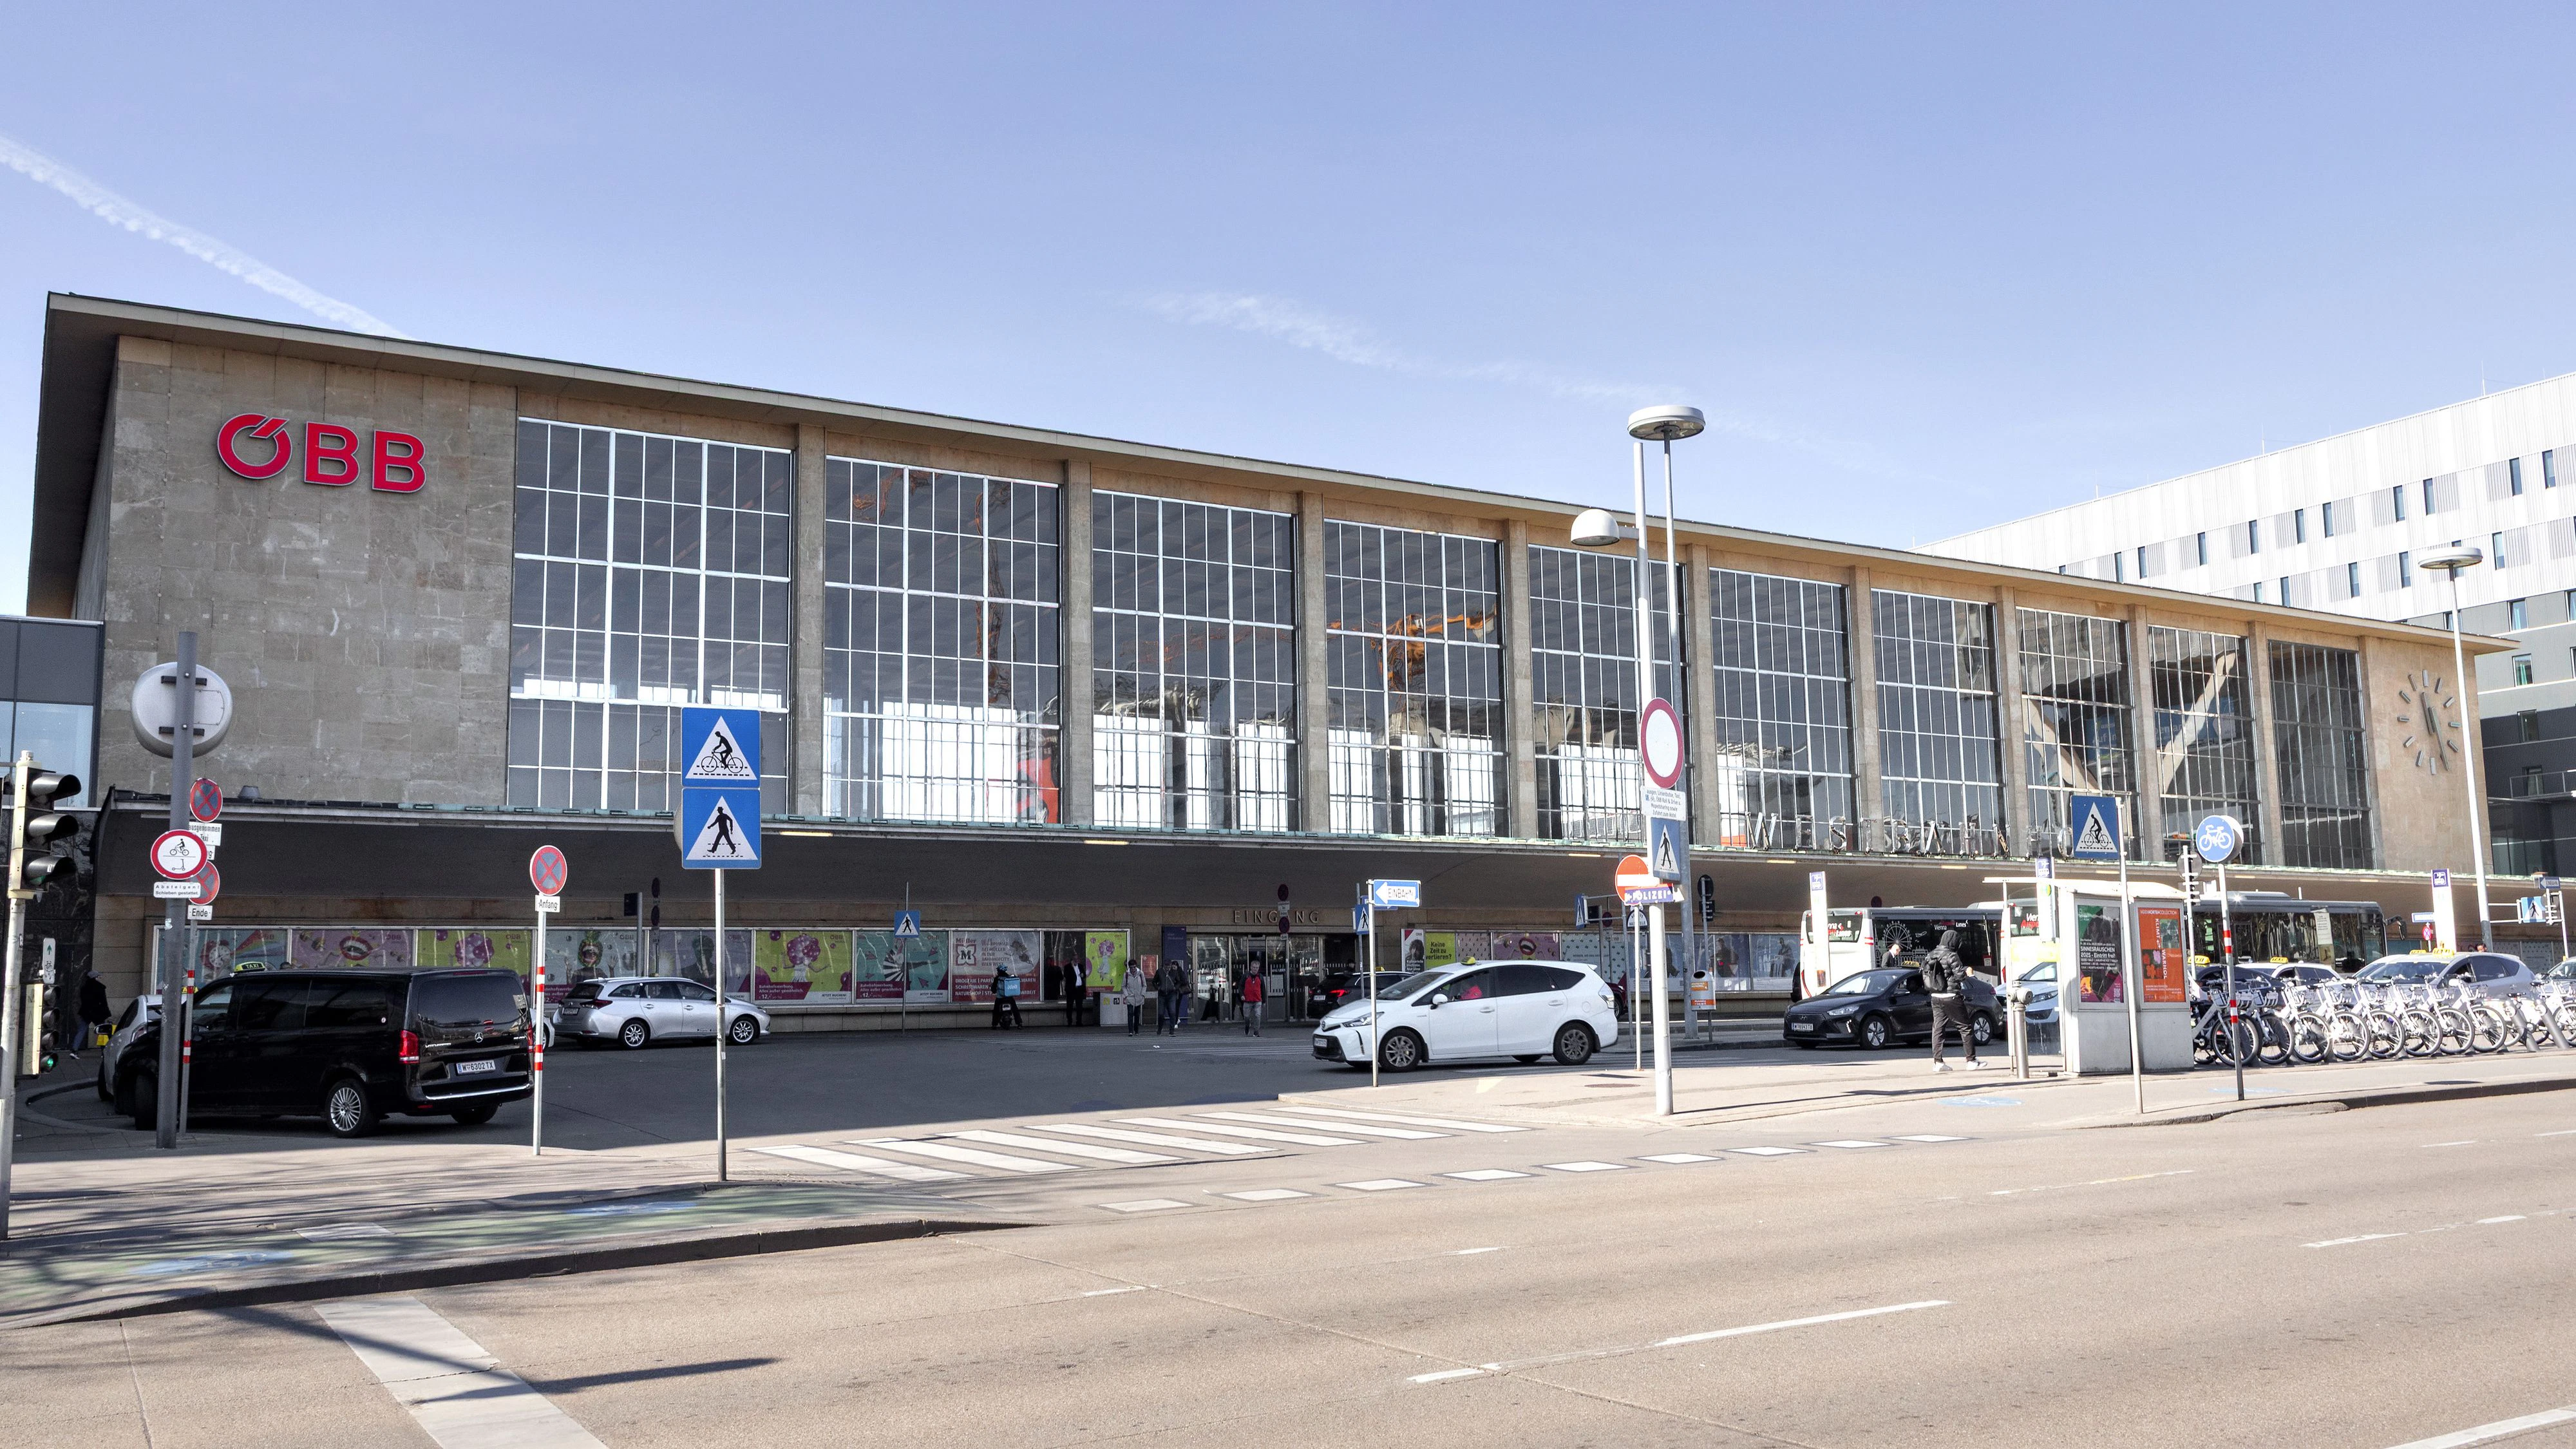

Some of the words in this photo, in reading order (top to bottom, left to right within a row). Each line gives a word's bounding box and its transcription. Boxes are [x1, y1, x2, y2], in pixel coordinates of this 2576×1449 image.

[217, 413, 426, 493] ÖBB
[1744, 811, 2073, 859] WESTBAHNHO
[1388, 888, 1414, 898] EINBAHN
[539, 899, 558, 911] Anfang
[192, 908, 208, 917] Ende
[1233, 910, 1319, 923] EINGNG
[2026, 913, 2040, 922] Vien
[961, 951, 971, 960] M
